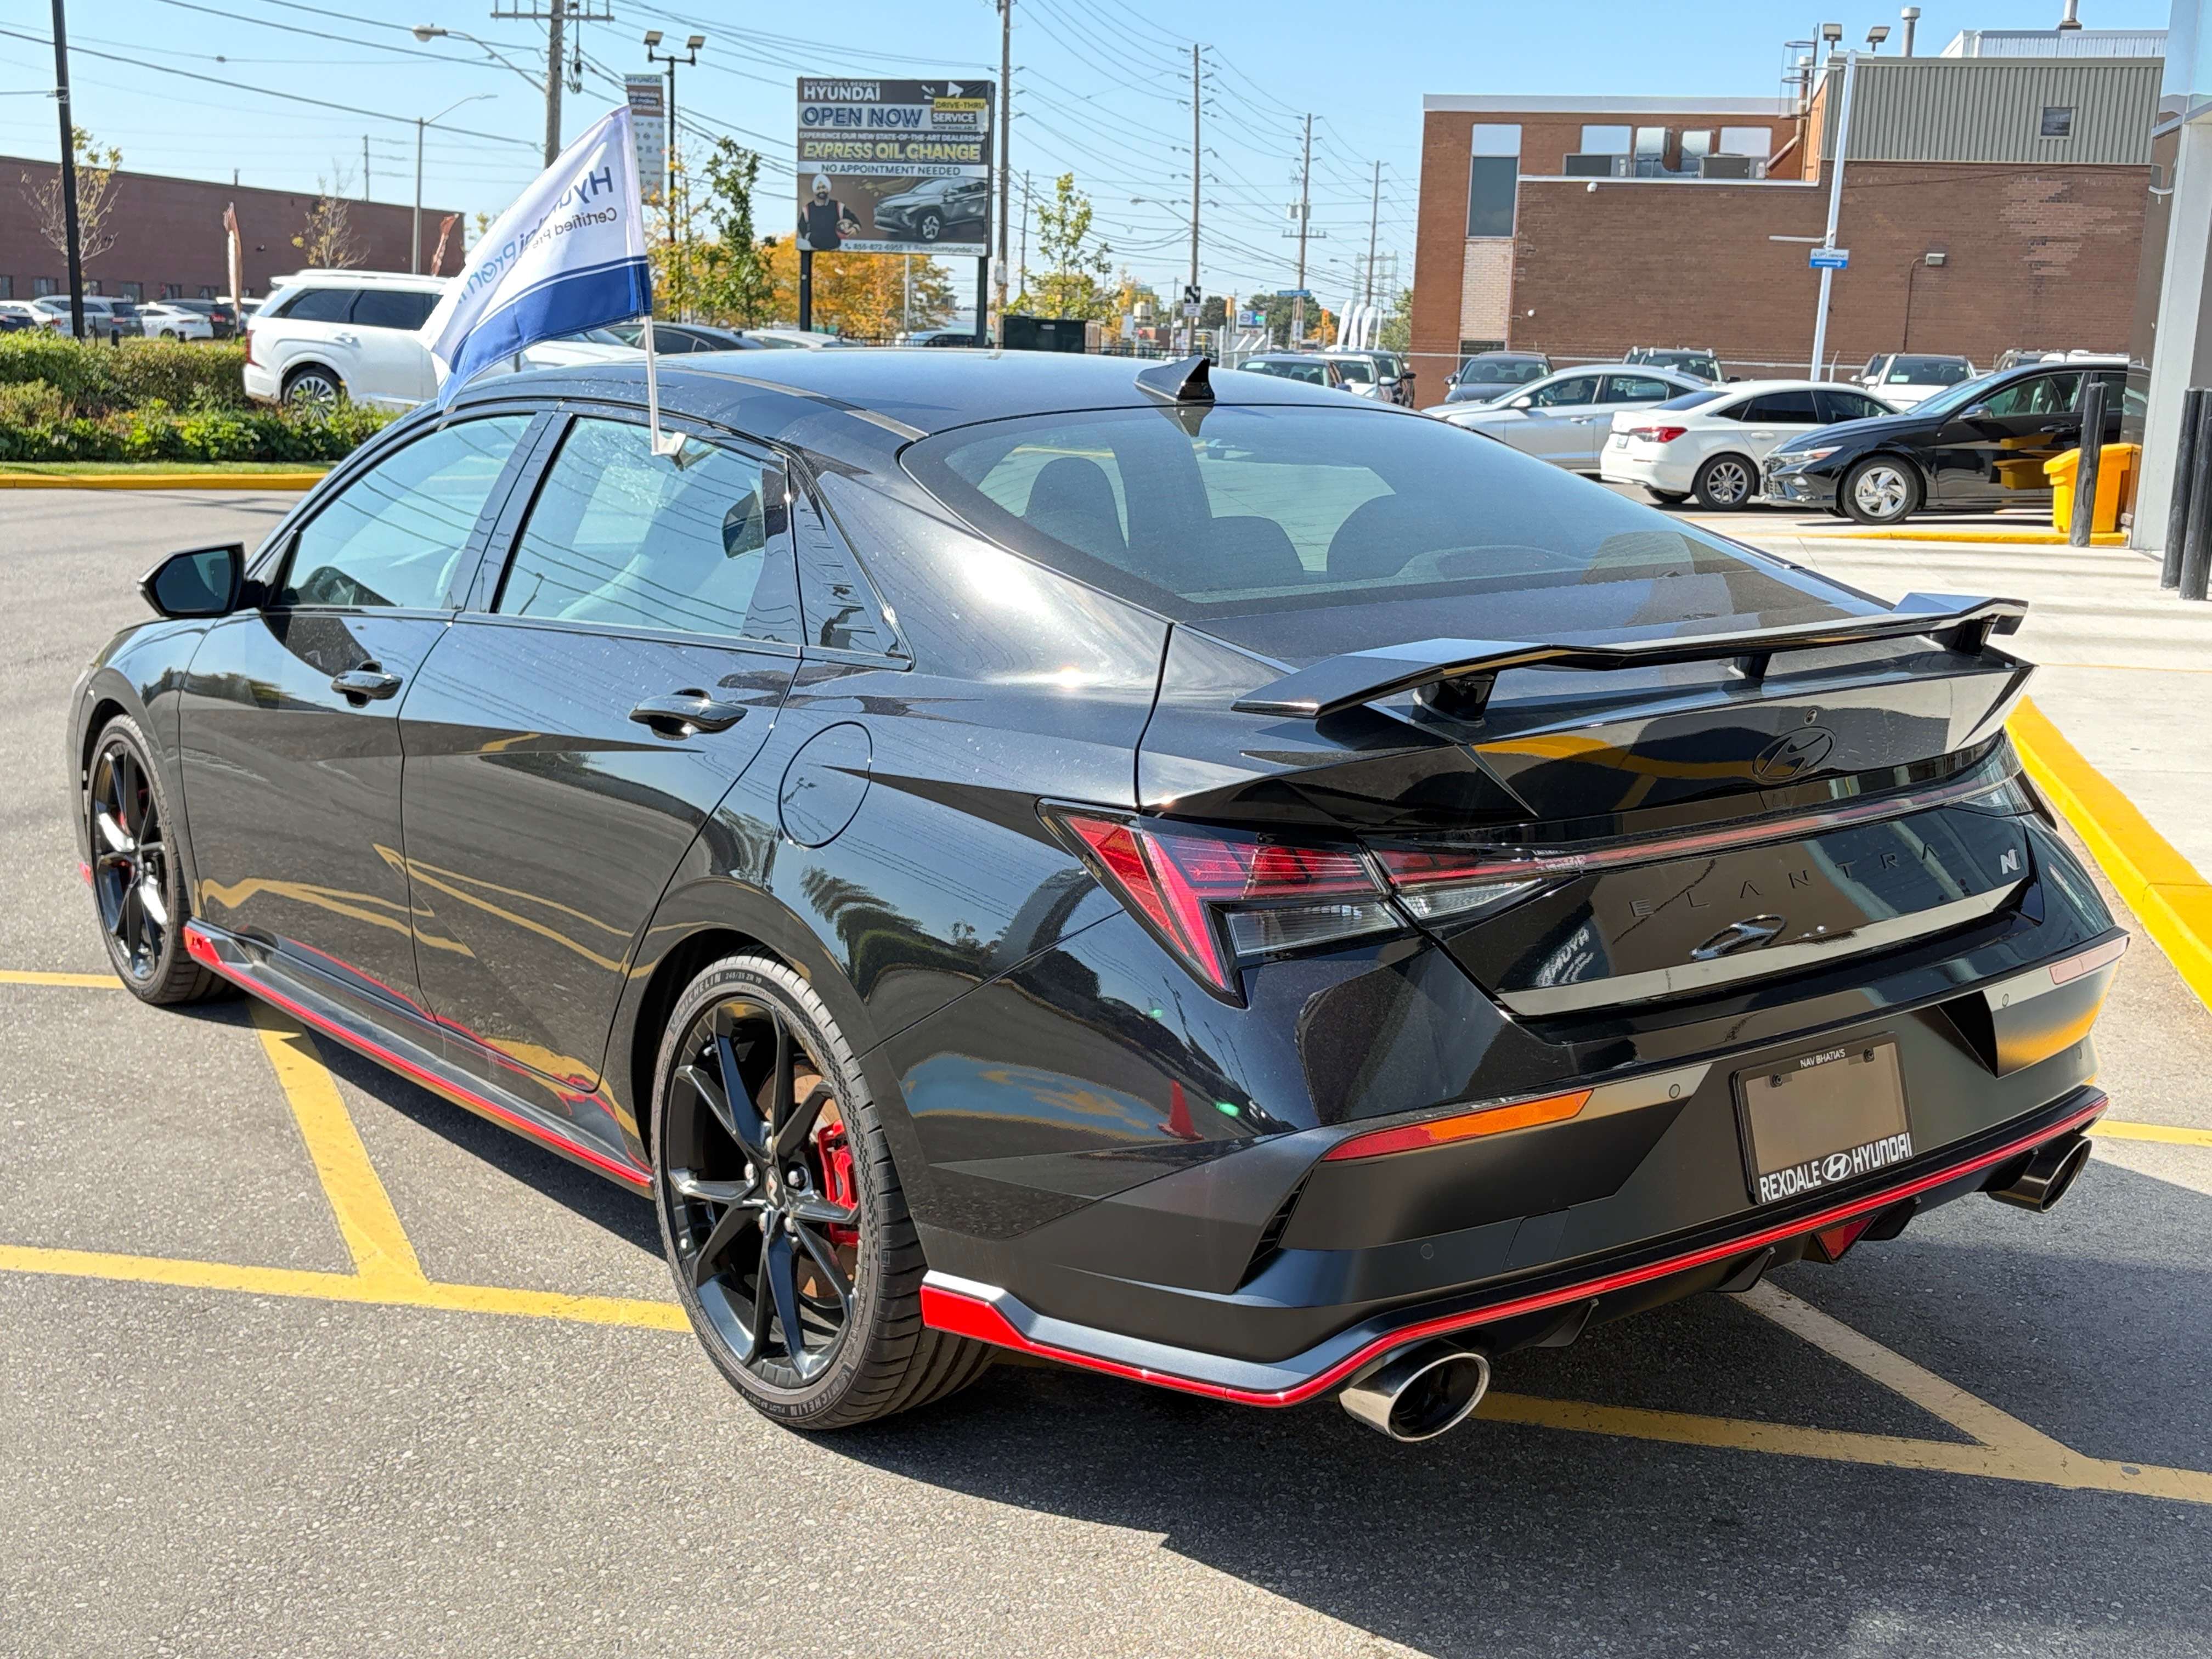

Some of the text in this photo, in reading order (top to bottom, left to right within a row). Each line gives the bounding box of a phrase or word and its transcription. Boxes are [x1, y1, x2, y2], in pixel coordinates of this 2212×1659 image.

[804, 86, 881, 101] HYUNDAI
[935, 101, 985, 109] DRIVE-THRU
[802, 106, 923, 128] OPEN NOW
[932, 112, 975, 123] SERVICE
[802, 141, 981, 163] EXPRESS OIL CHANGE
[821, 163, 961, 176] NO APPOINTMENT NEEDED
[2000, 849, 2021, 874] N
[1629, 842, 1940, 917] ELANTRA
[678, 973, 721, 1015] MICHELIN
[1800, 1048, 1846, 1068] NAV BHATIA'S
[1760, 1132, 1913, 1203] REXDALE HYUNDAI
[791, 1381, 840, 1417] MICHELIN
